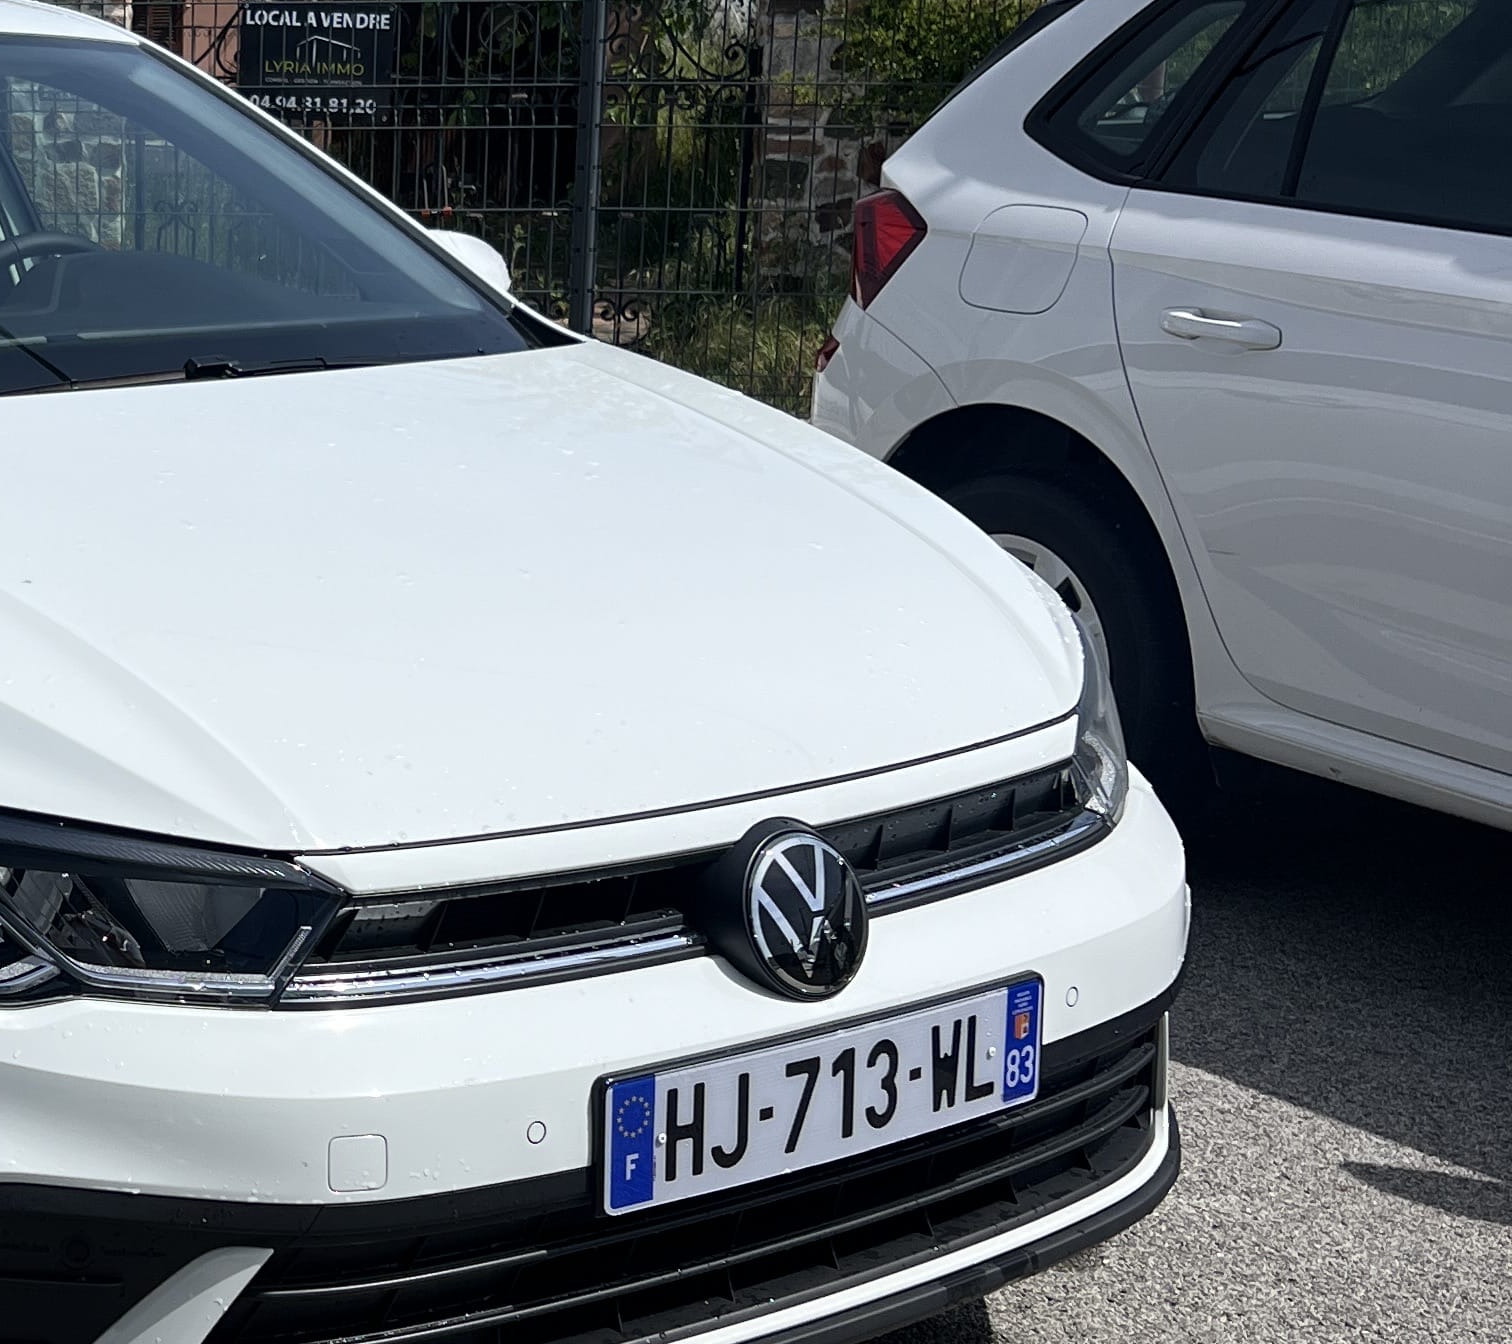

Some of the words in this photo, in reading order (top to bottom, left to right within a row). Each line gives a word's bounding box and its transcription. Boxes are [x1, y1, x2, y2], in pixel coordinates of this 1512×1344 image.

[246, 9, 301, 27] LOCAL
[307, 11, 318, 28] A
[320, 11, 391, 30] VENDRE
[265, 60, 312, 74] LYRIA
[317, 62, 365, 76] IMMO
[1006, 1044, 1035, 1088] 83
[664, 1014, 994, 1182] HJ-713-WL
[624, 1152, 640, 1181] F
